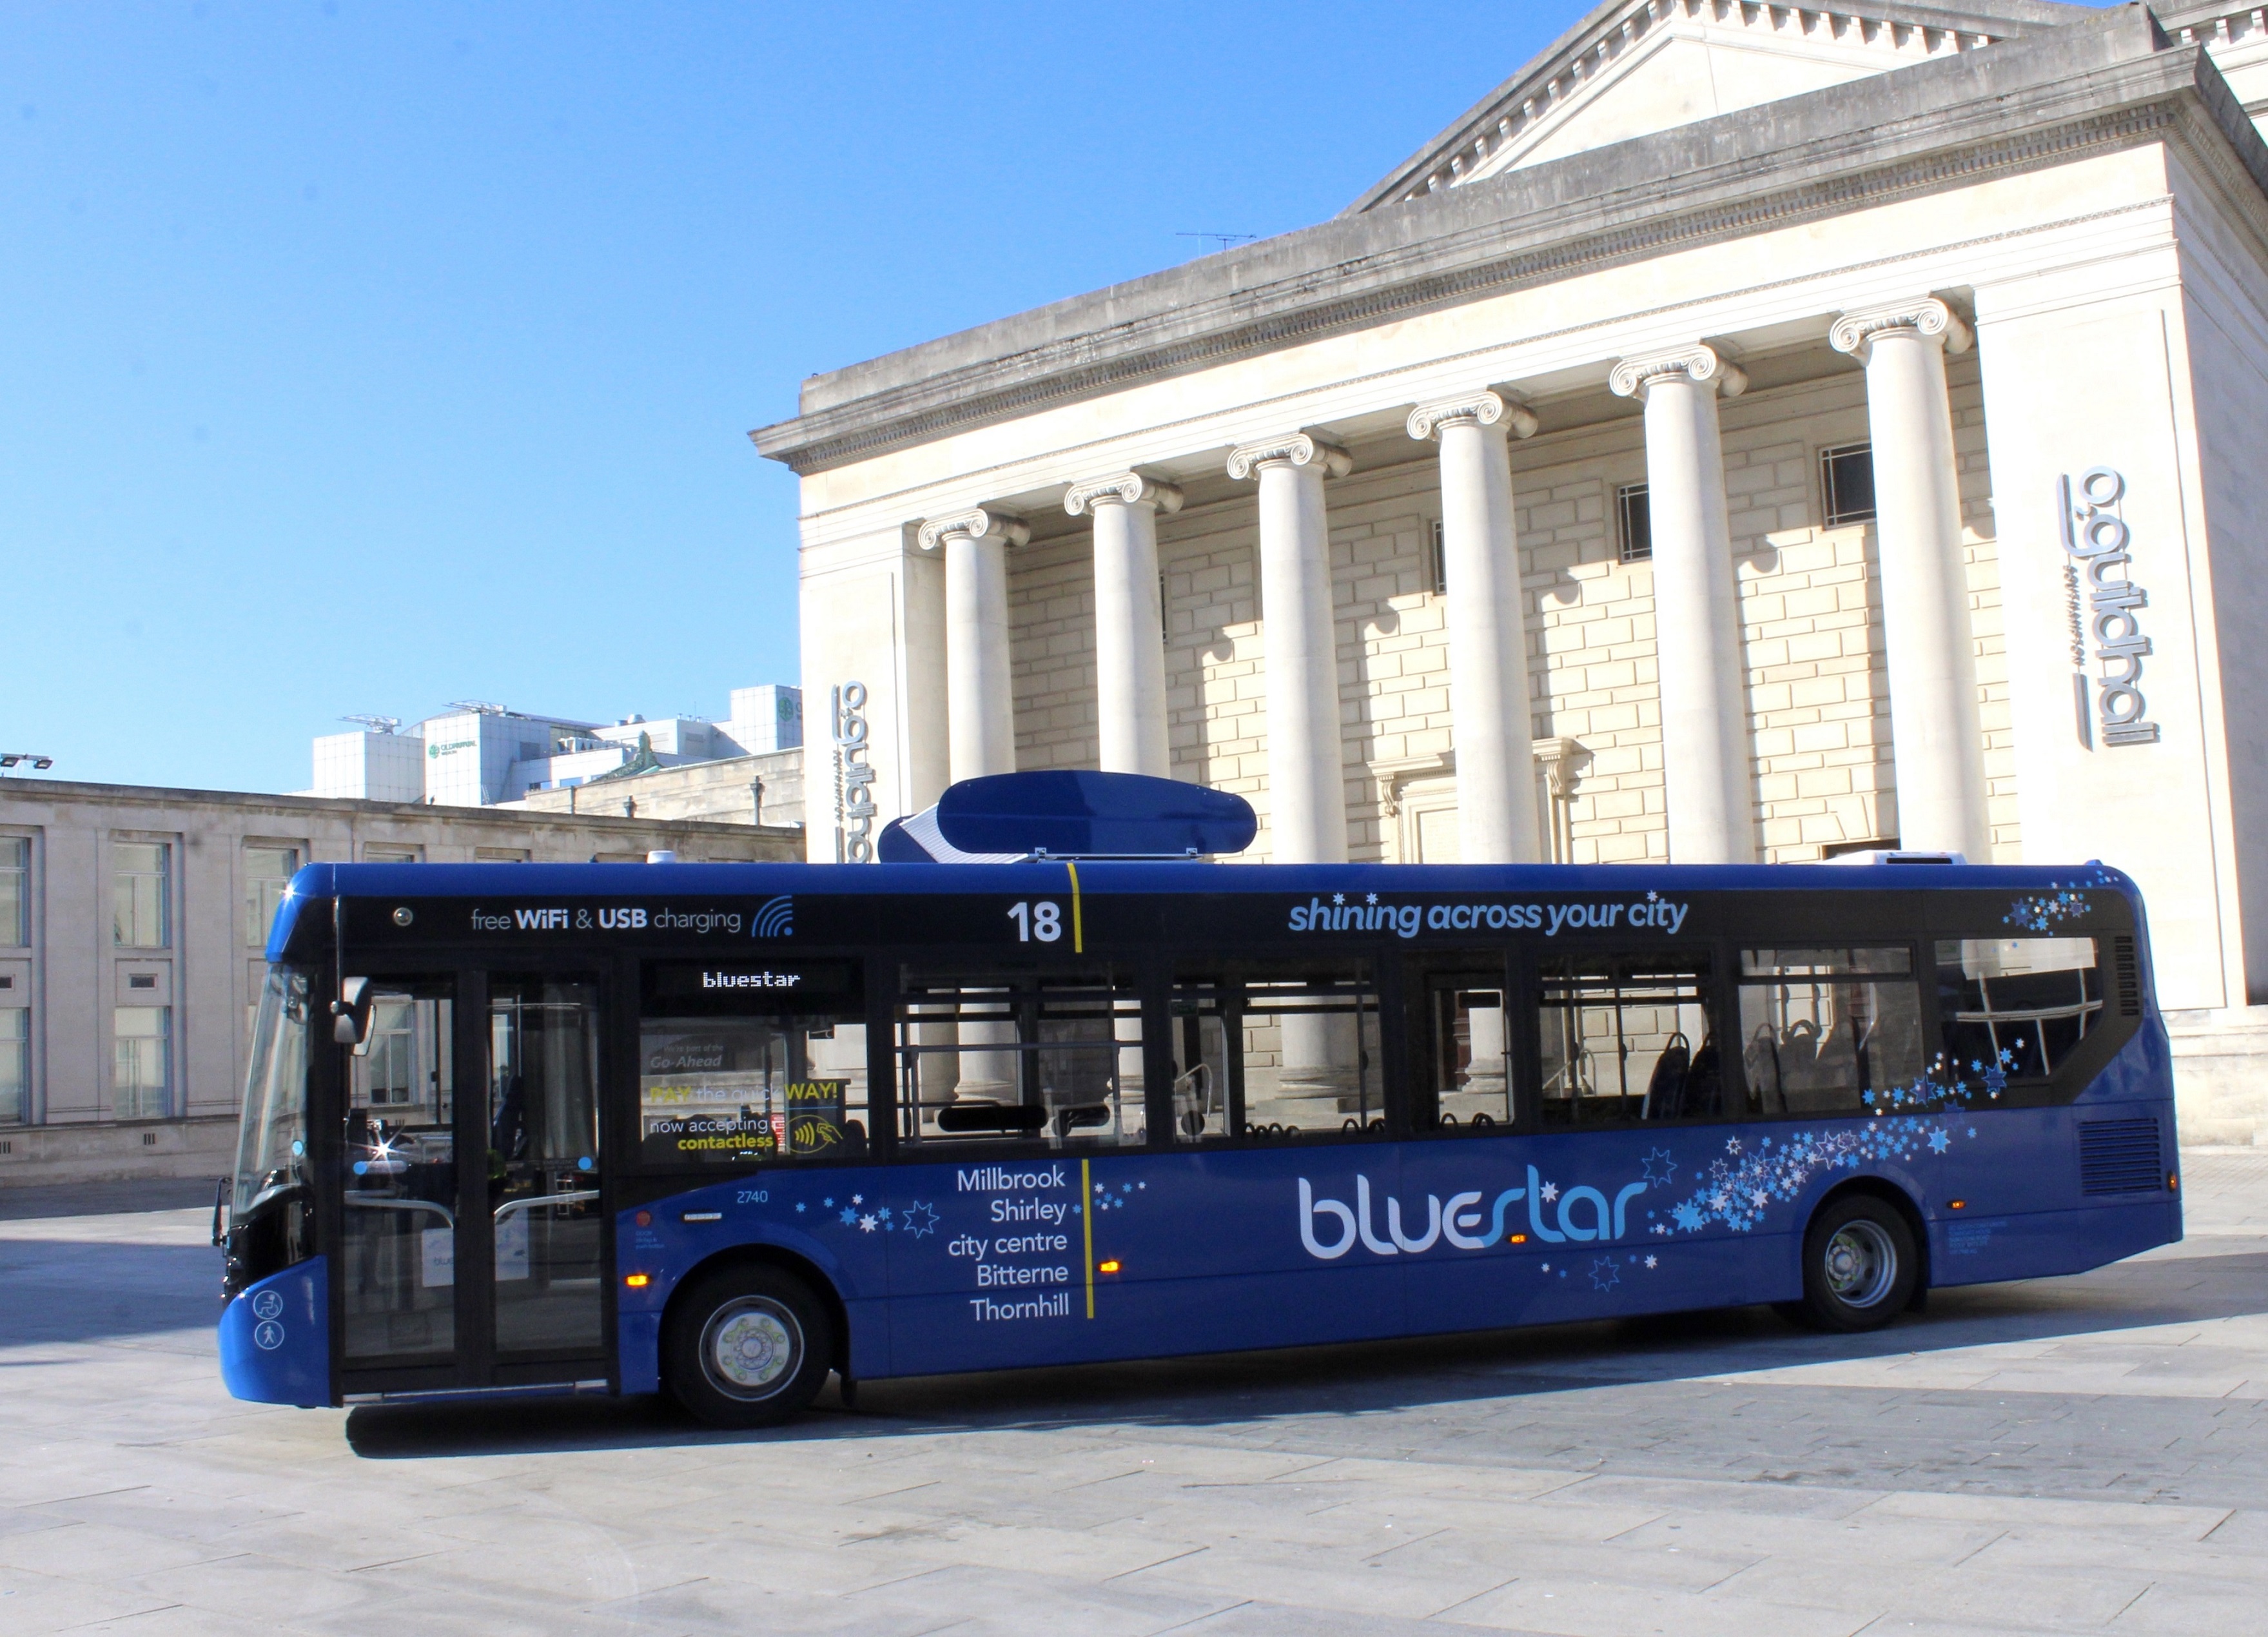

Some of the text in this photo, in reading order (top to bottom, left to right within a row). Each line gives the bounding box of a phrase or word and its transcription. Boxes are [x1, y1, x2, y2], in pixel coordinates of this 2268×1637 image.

[2057, 473, 2155, 745] guildhall
[2063, 564, 2085, 666] SOUTHAMPTON
[831, 683, 875, 864] guildha
[471, 907, 741, 934] free WiFi & USB charging
[1007, 901, 1062, 942] 18
[1288, 890, 1688, 939] shining across your city
[703, 971, 801, 988] bluestar
[650, 1082, 837, 1106] PAY the quick WAY!
[650, 1116, 768, 1135] now accepting
[678, 1132, 774, 1150] contactless
[957, 1164, 1066, 1191] Millbrook
[737, 1190, 768, 1204] 2740
[990, 1197, 1067, 1225] Shirley
[1298, 1163, 1648, 1260] bluestar
[948, 1232, 1068, 1261] city centre
[977, 1264, 1069, 1287] Bitterne
[970, 1292, 1070, 1322] Thornhill
